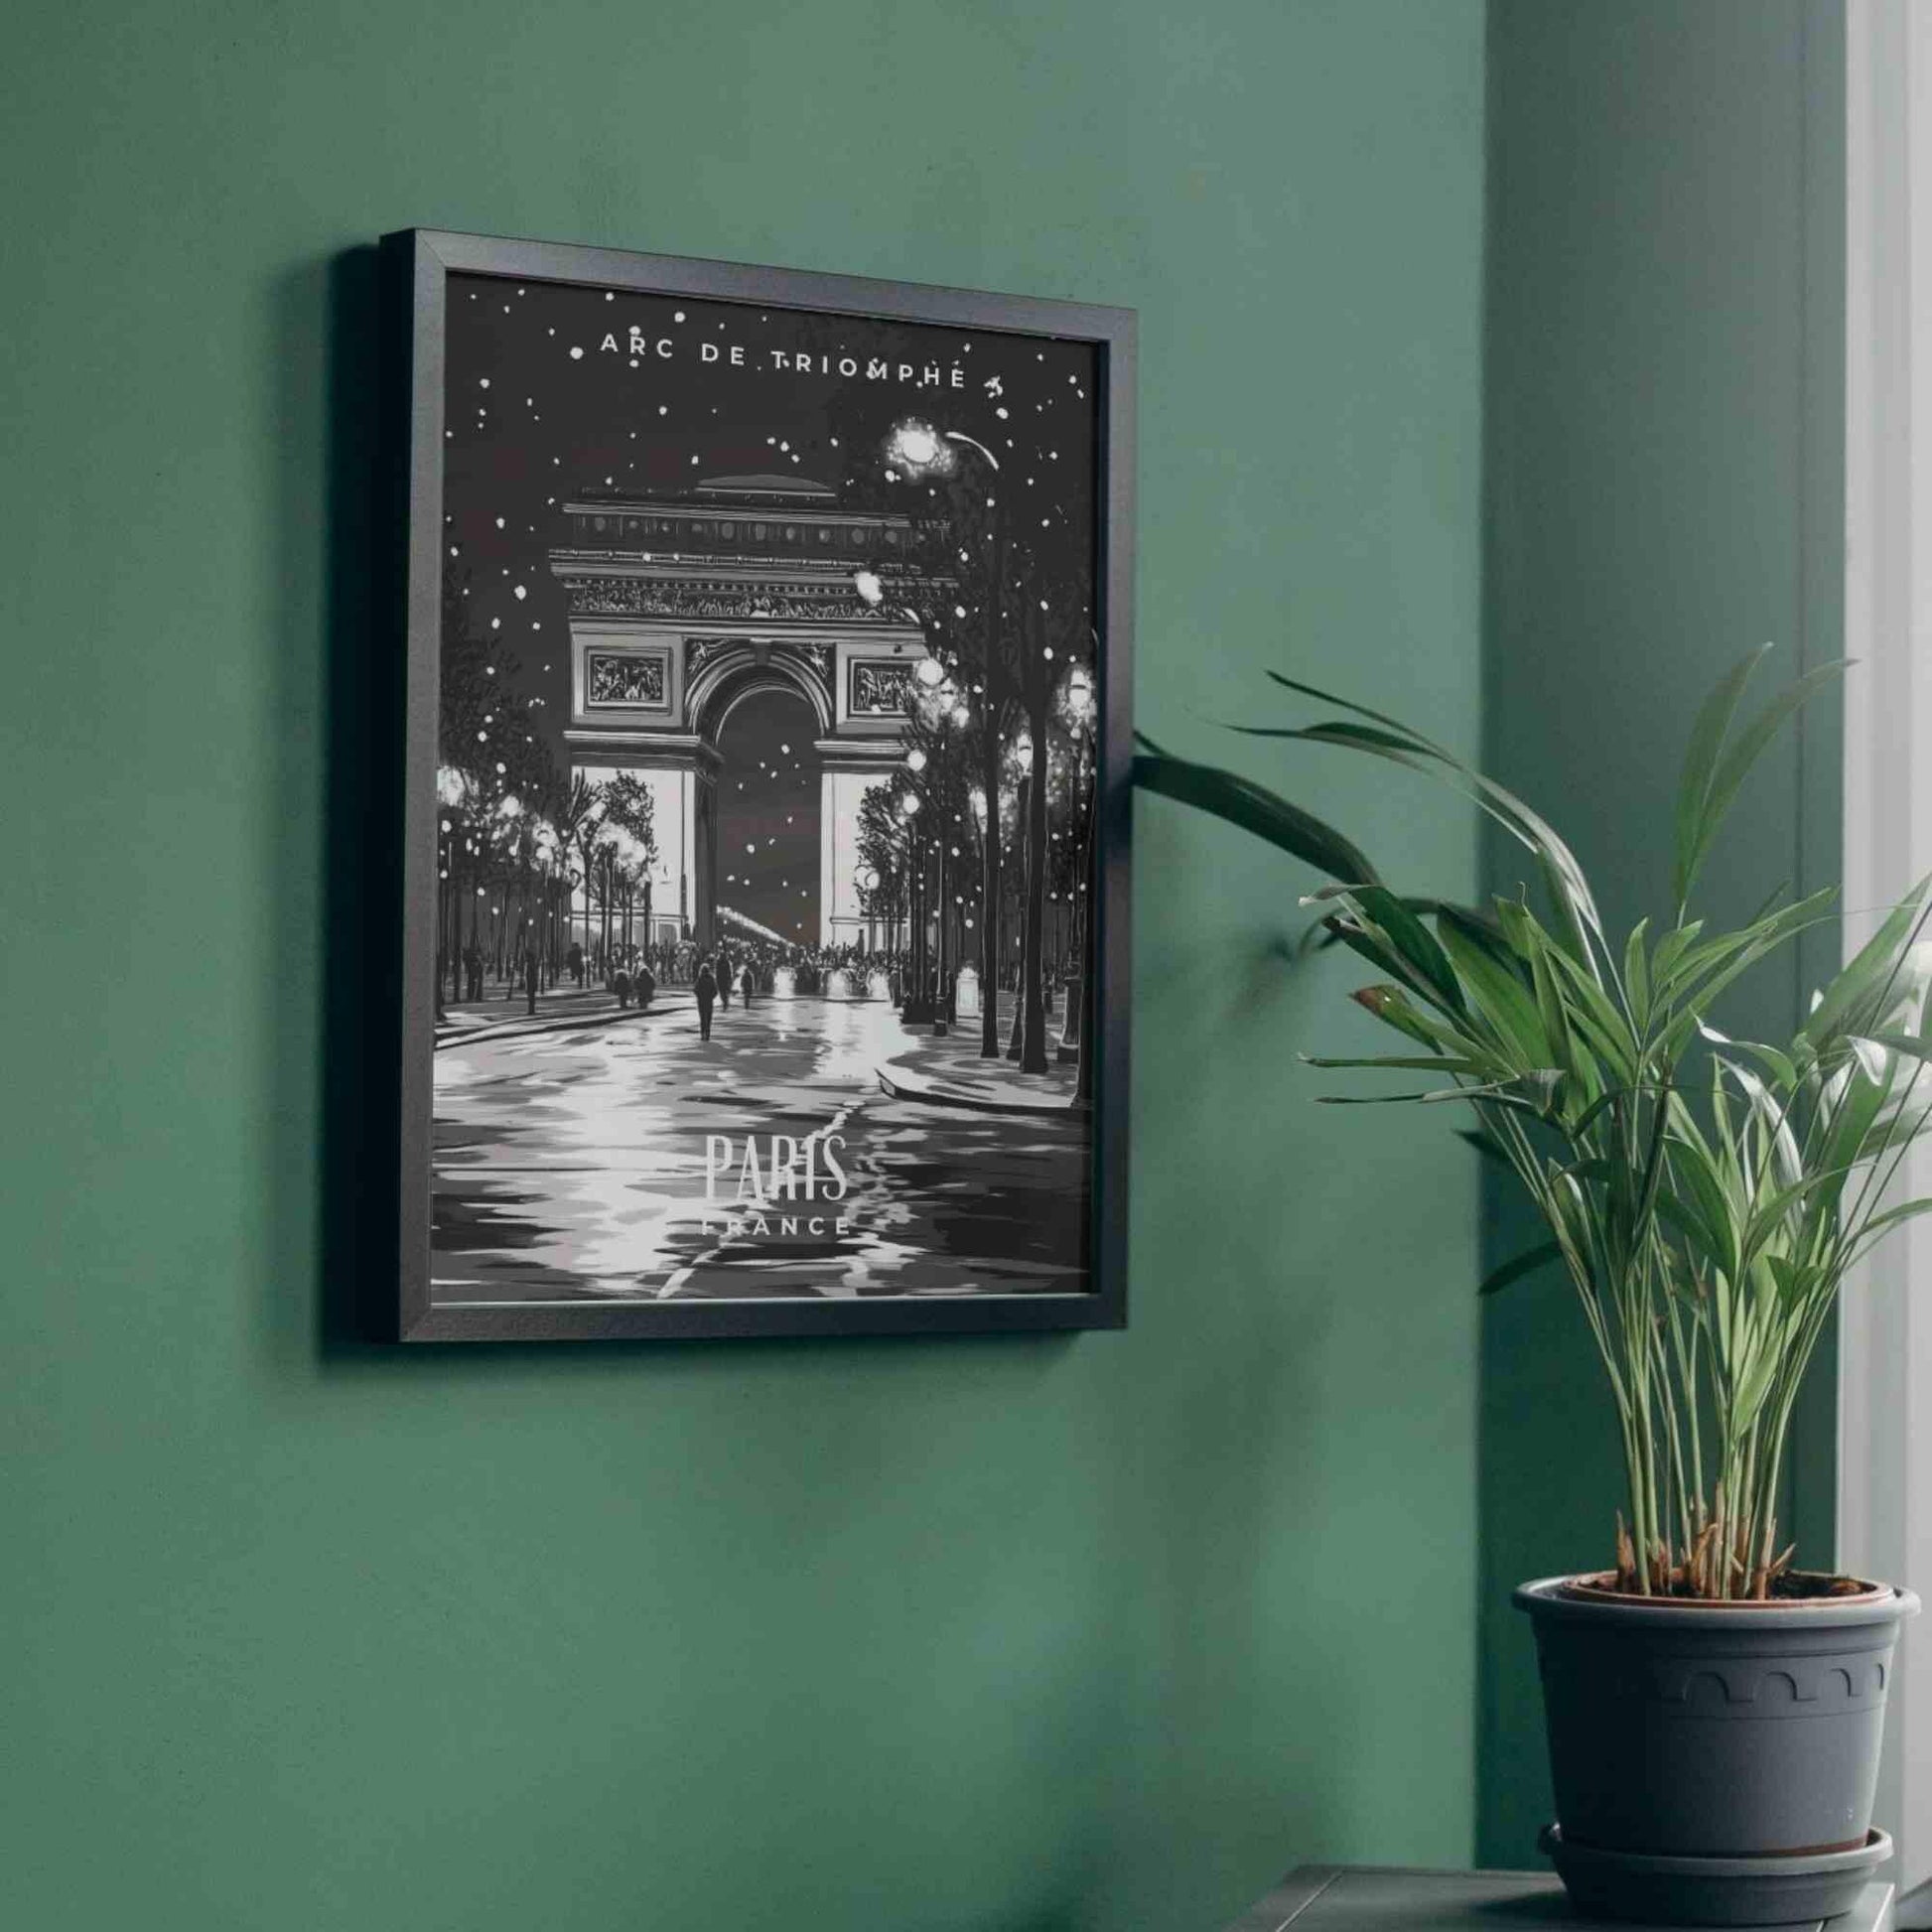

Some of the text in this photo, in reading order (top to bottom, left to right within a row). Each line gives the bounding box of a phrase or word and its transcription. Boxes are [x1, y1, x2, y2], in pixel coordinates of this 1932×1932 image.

[600, 333, 965, 388] ARC DE TRIOMPHE
[706, 1135, 847, 1201] PARIS
[702, 1216, 850, 1236] FRANCE
